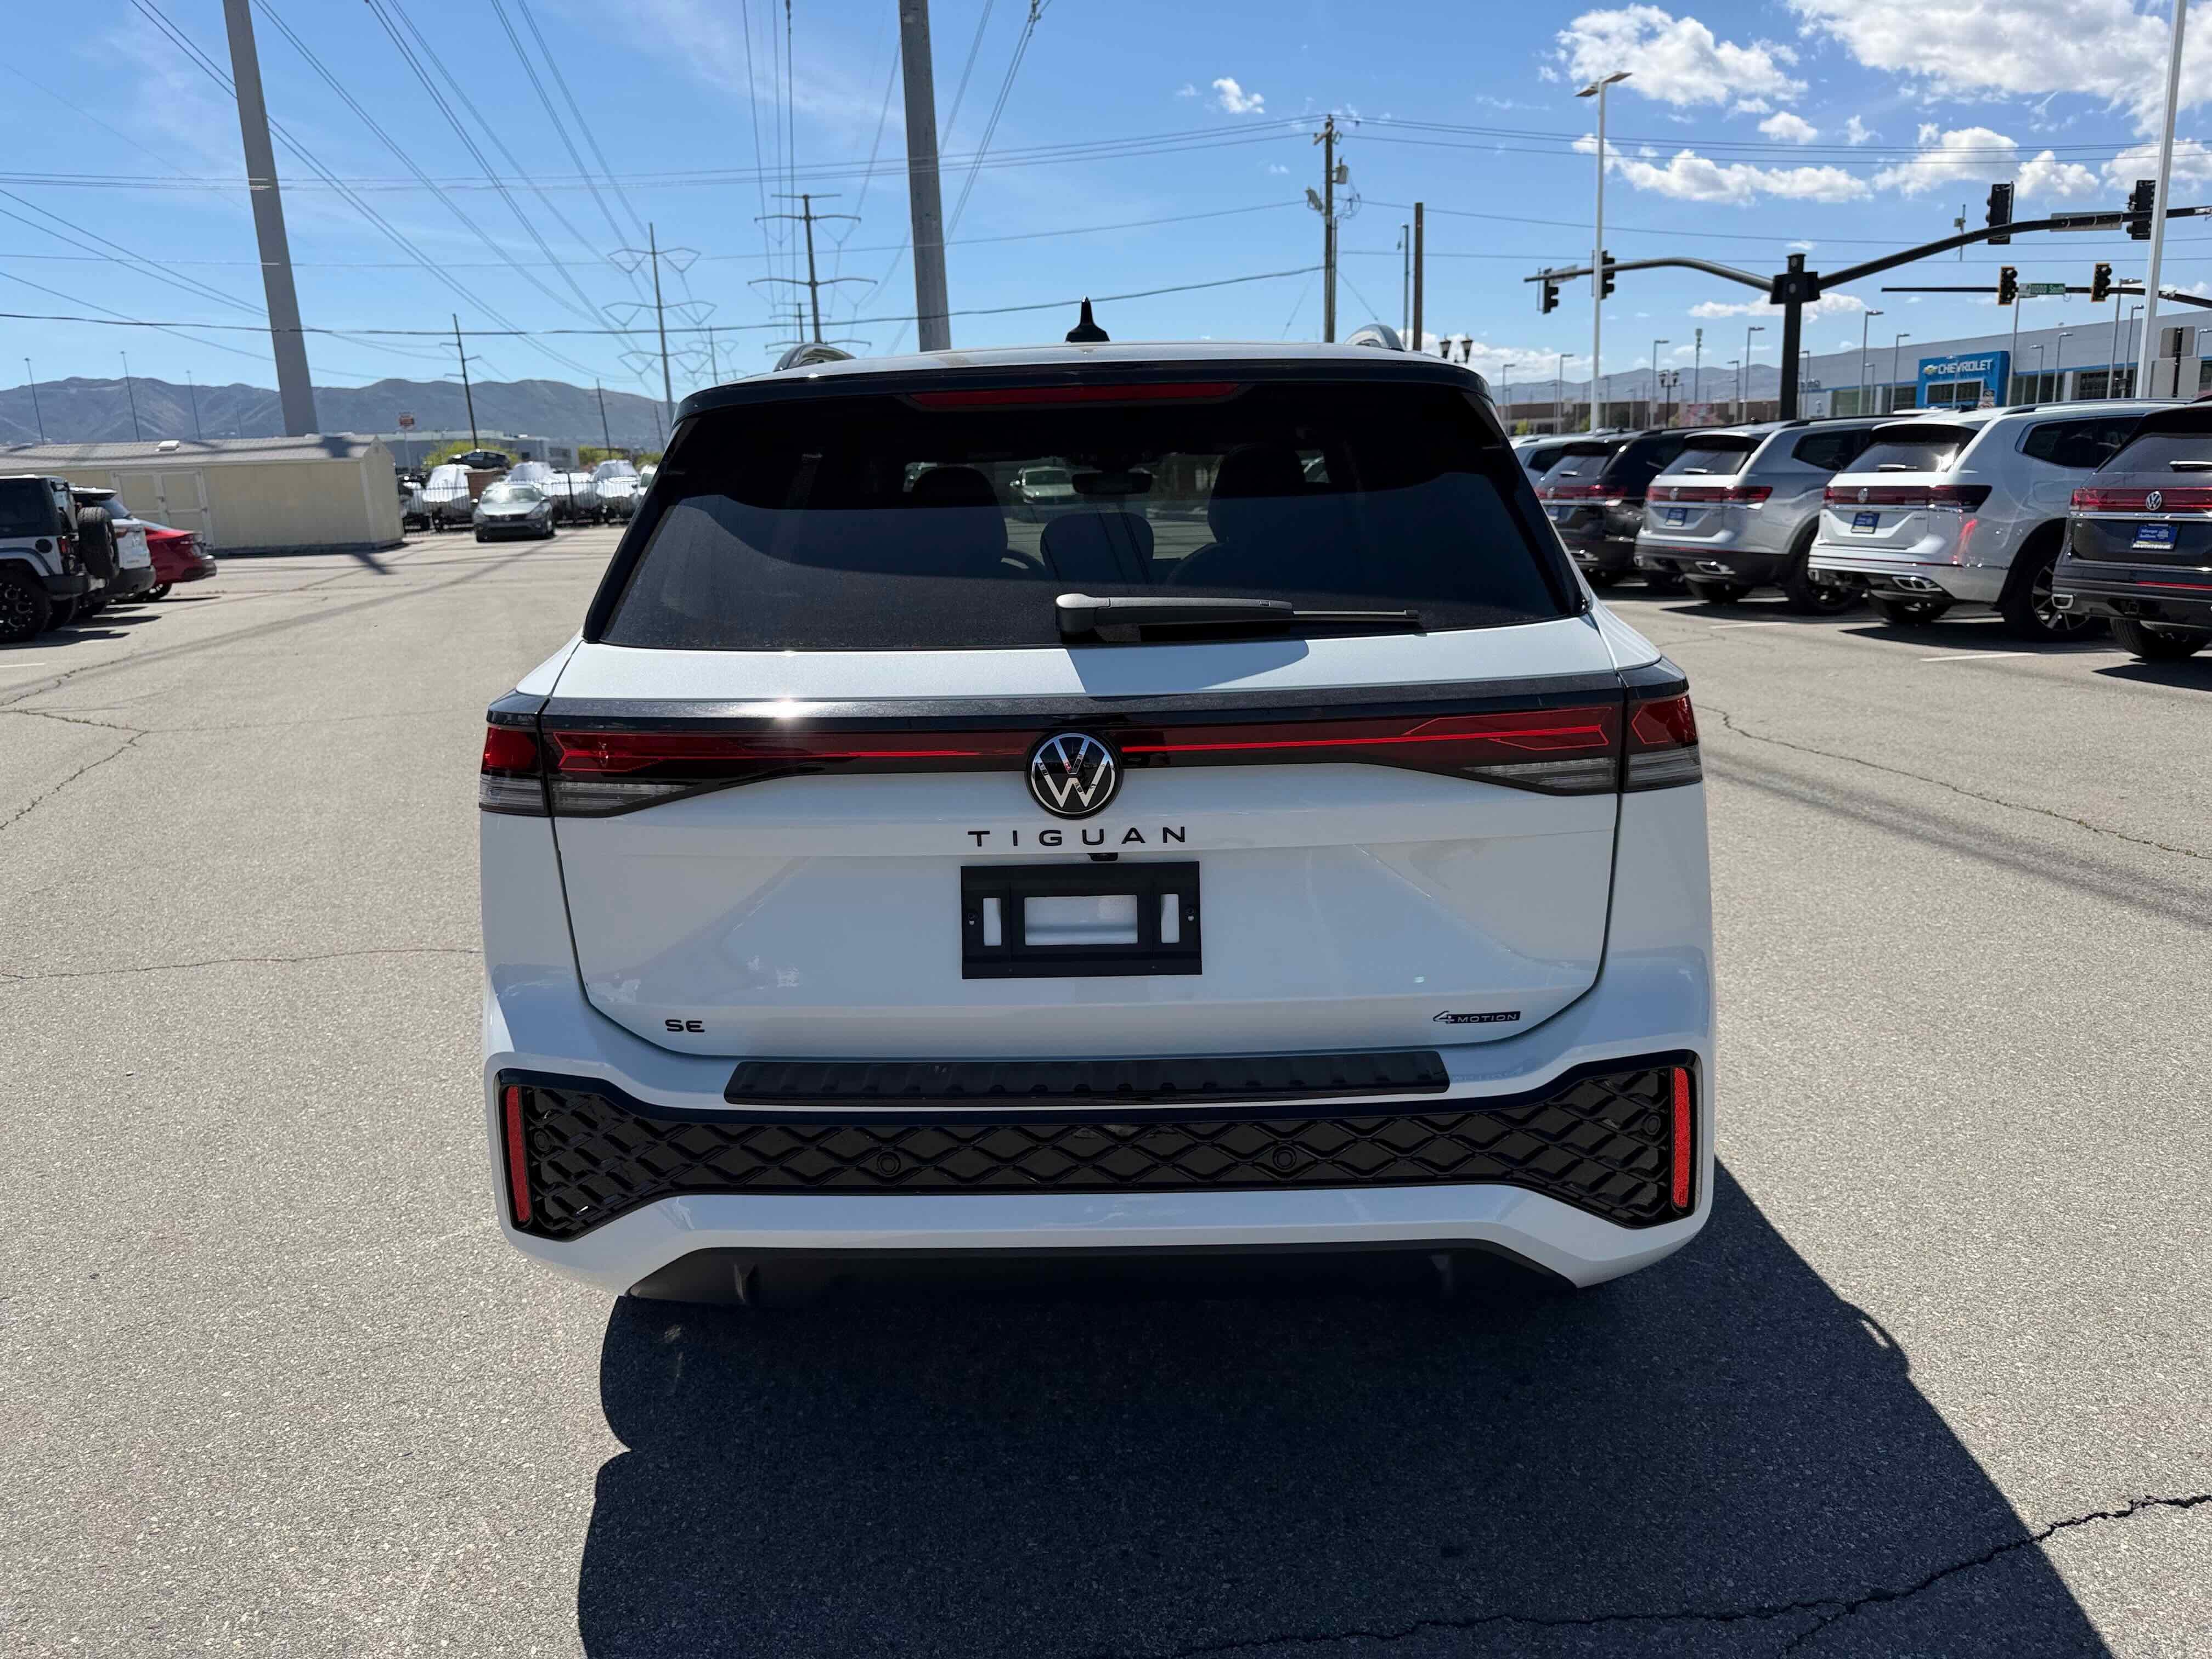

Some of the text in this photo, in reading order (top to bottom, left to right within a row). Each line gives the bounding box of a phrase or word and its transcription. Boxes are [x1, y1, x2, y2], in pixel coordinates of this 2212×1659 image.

[1938, 359, 1993, 374] CHEVROLET
[1031, 733, 1115, 814] VW
[968, 826, 1186, 847] TIGUAN
[665, 1019, 705, 1032] SE
